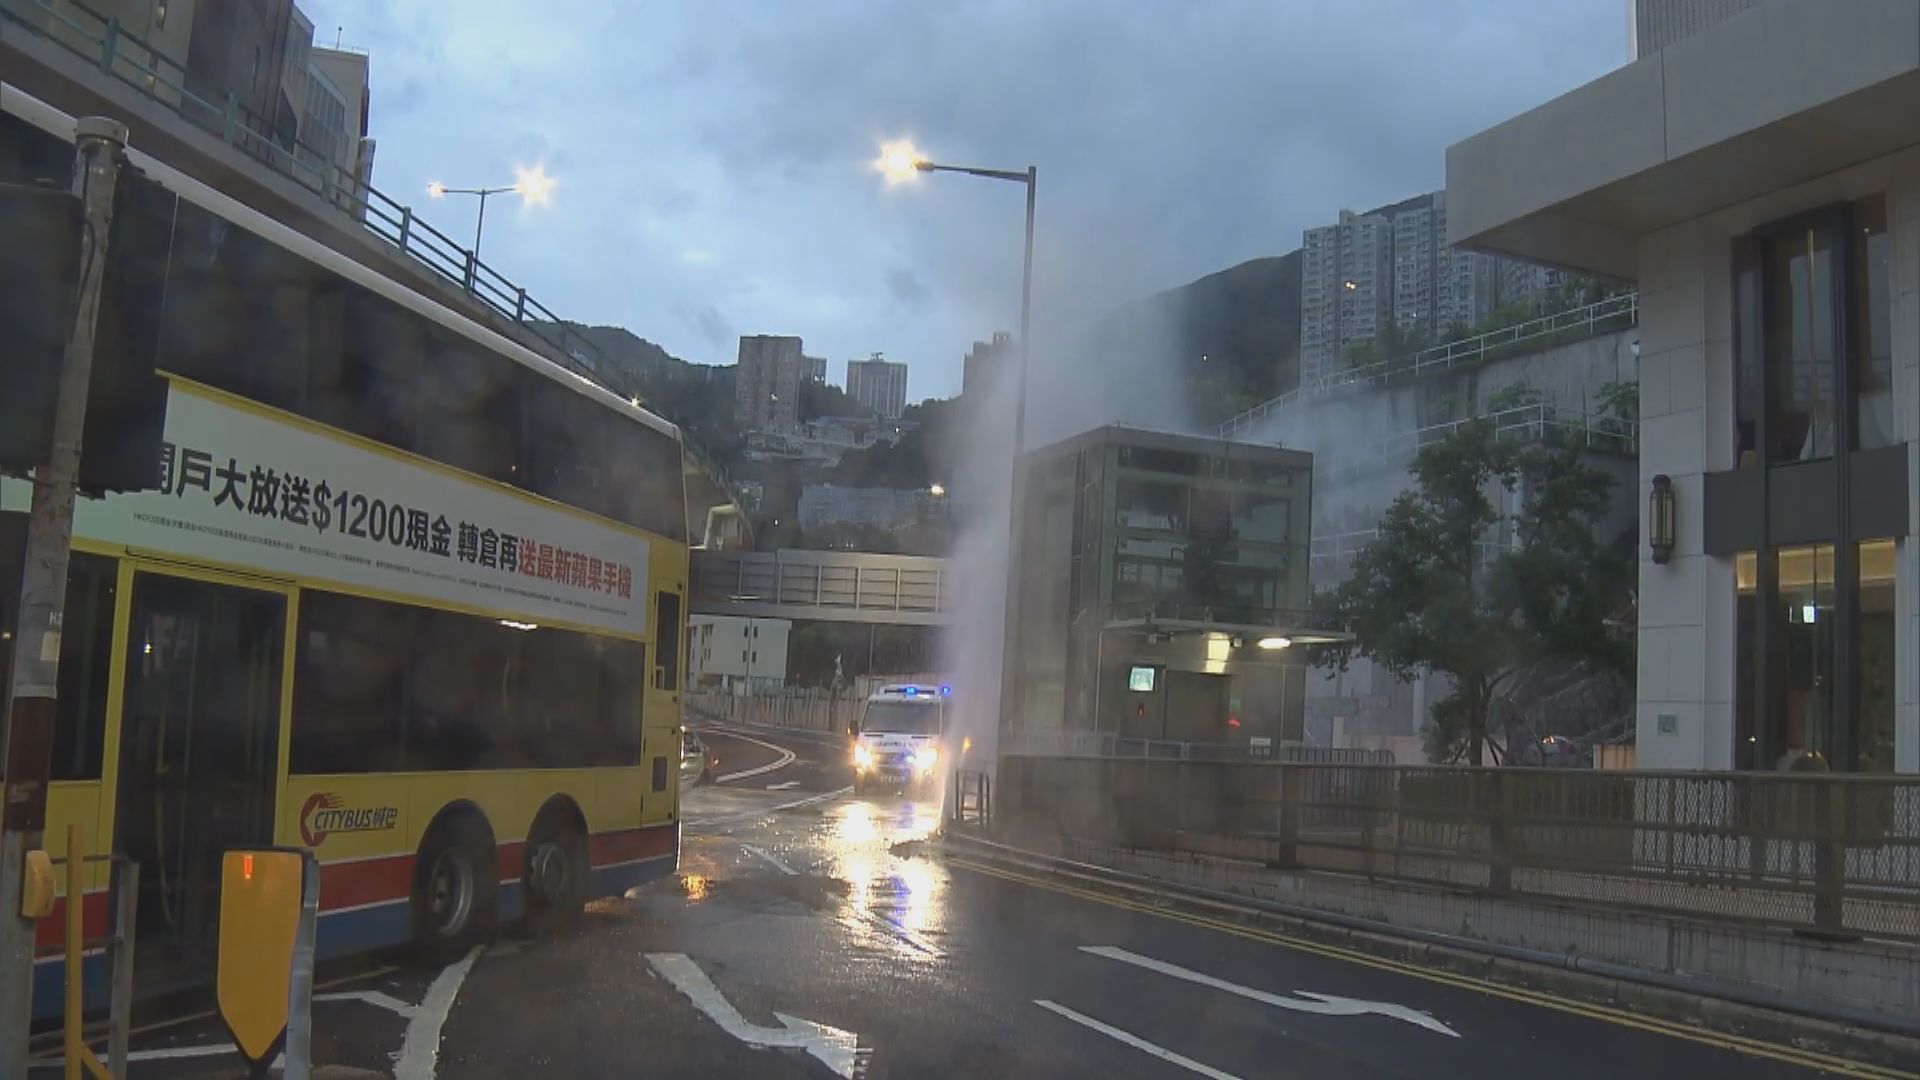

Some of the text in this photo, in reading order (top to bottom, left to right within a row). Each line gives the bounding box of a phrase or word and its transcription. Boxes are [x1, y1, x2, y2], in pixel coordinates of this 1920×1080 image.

[457, 520, 632, 599] 轉倉再送最新蘋果手機
[314, 809, 372, 829] CITYBUS
